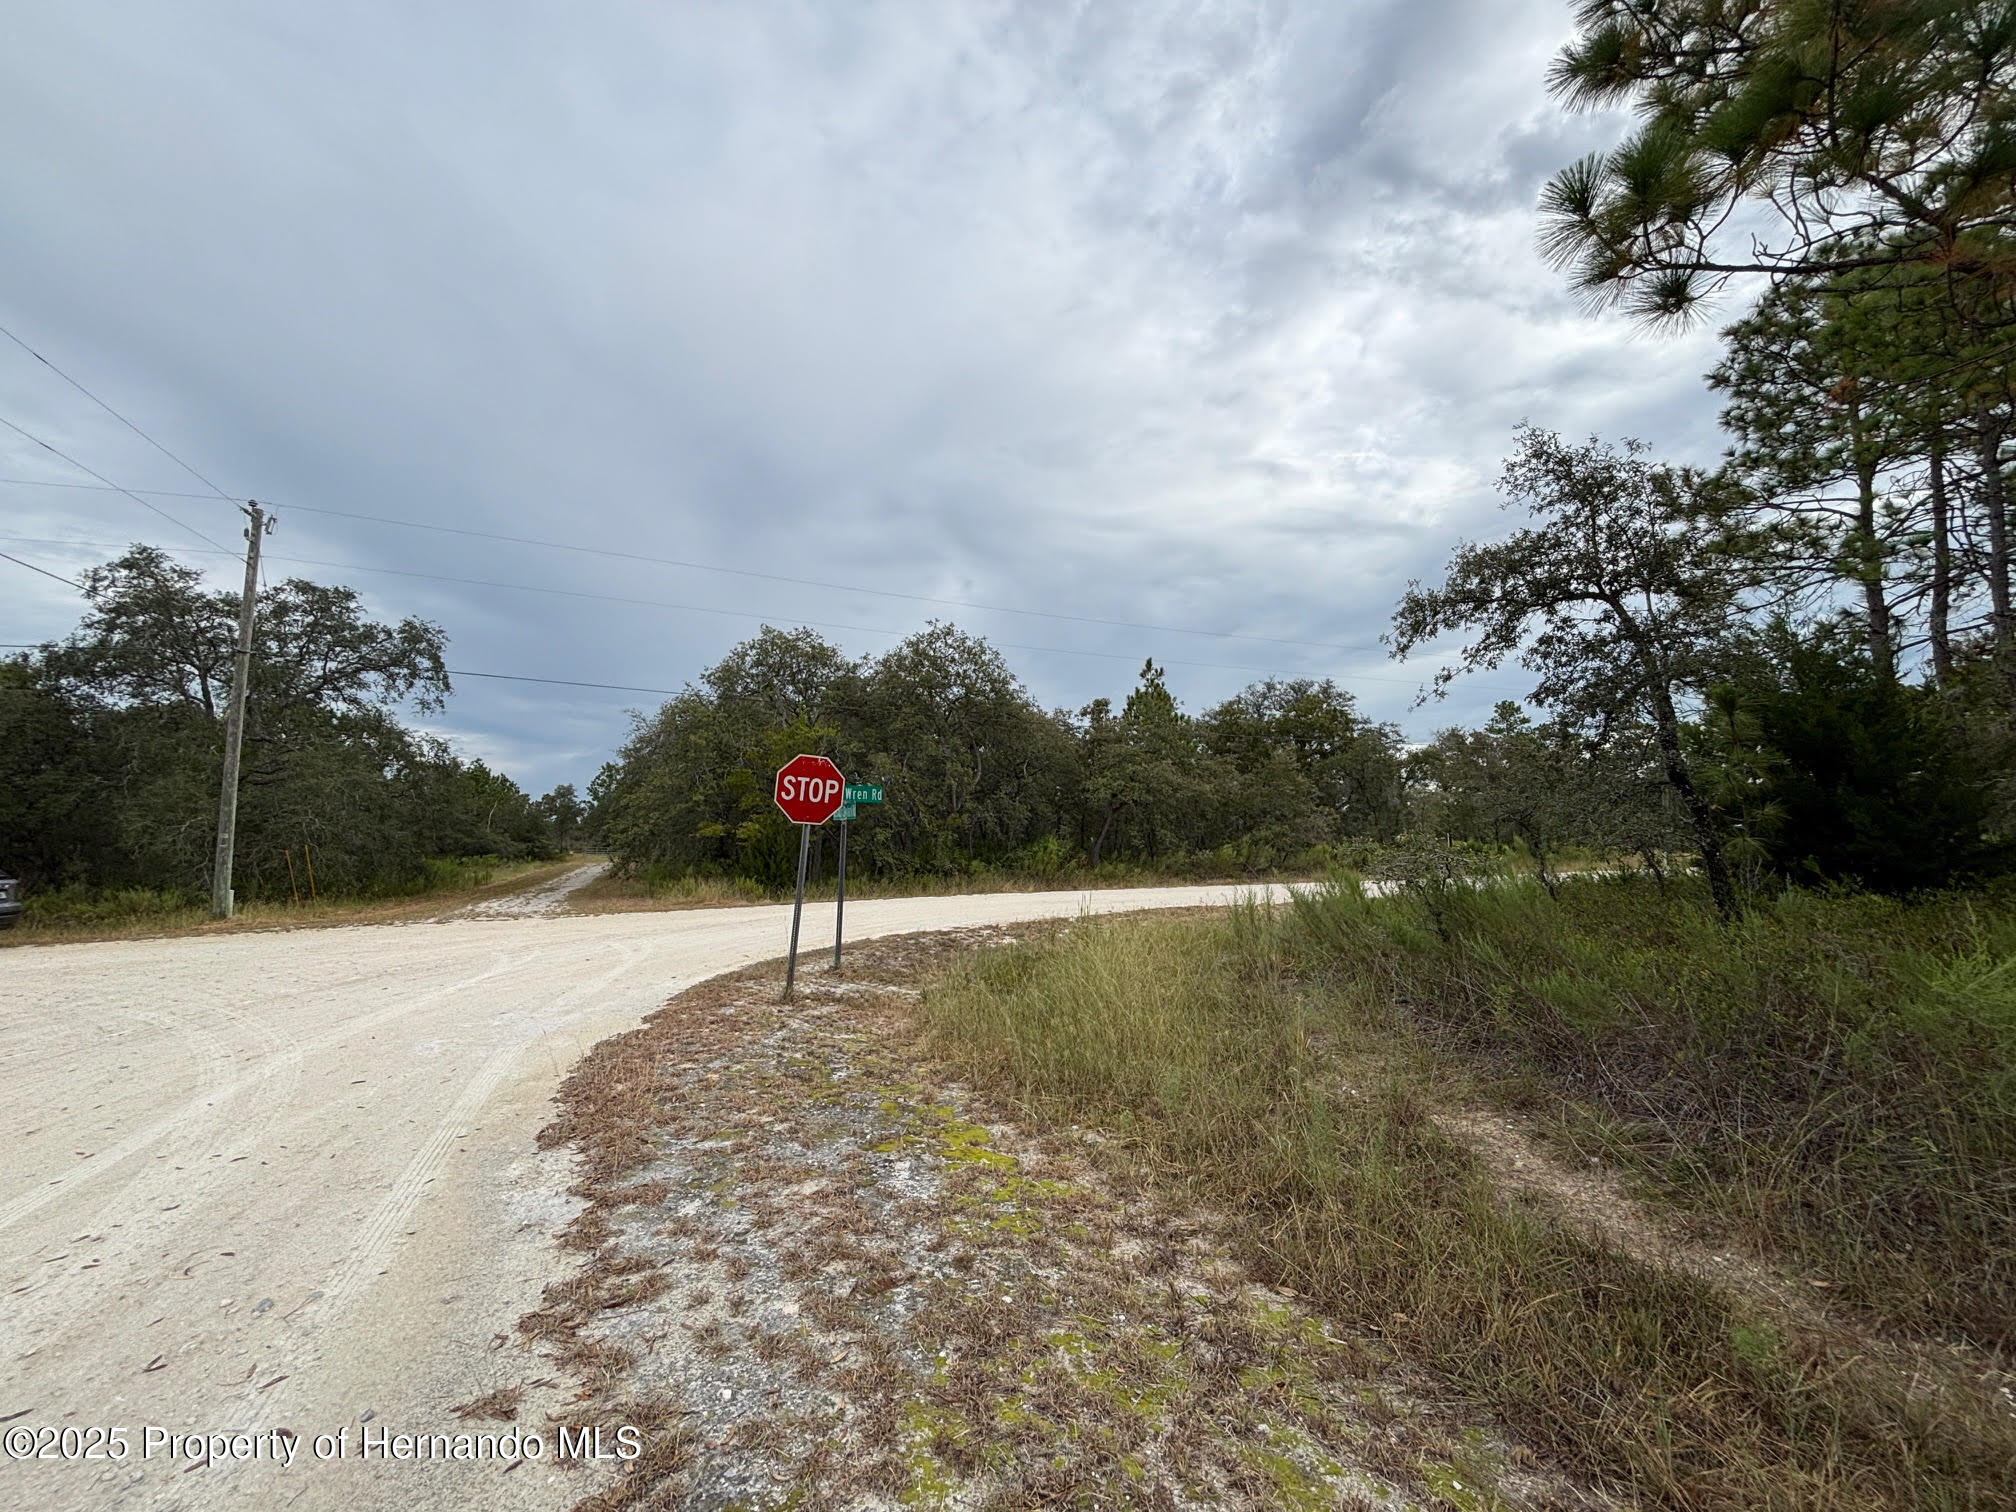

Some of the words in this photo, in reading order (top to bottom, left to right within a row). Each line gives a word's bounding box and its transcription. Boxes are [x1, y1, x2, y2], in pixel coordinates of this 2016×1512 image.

[781, 775, 840, 803] STOP
[845, 788, 868, 801] Wren
[871, 788, 883, 801] Rd
